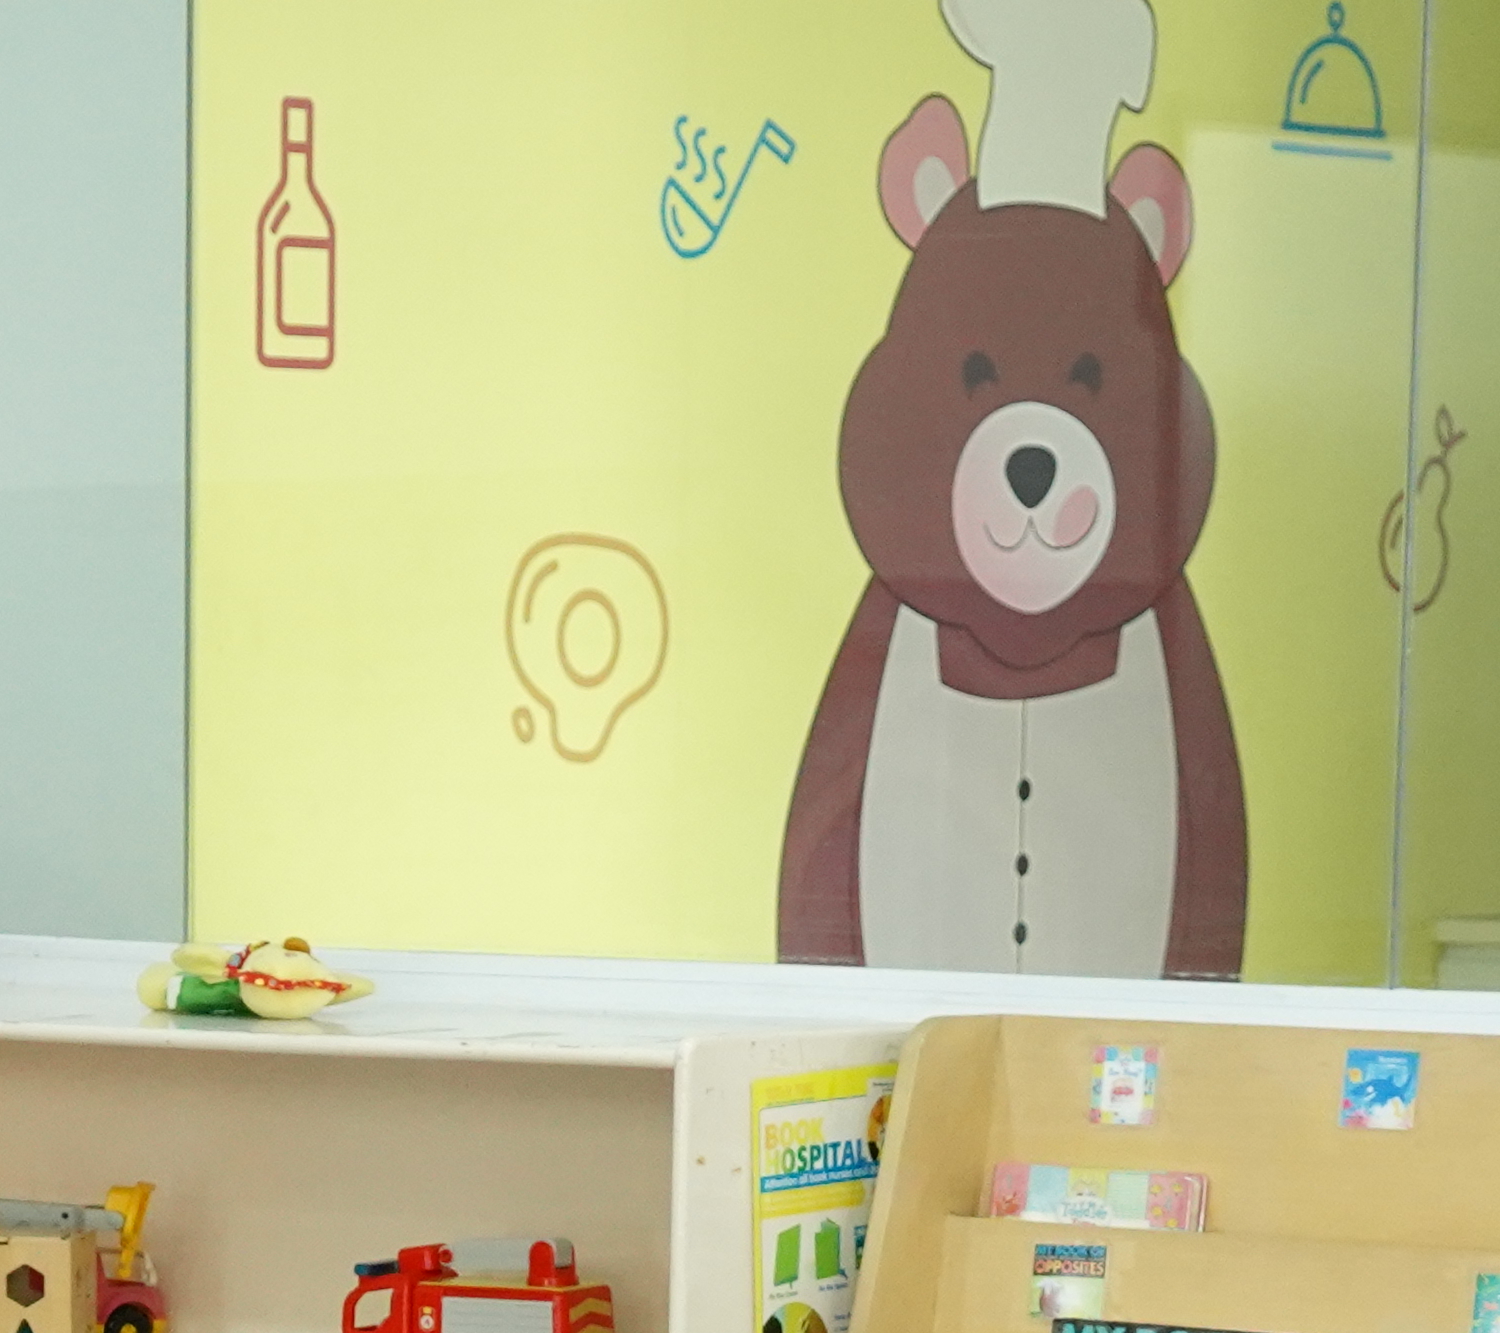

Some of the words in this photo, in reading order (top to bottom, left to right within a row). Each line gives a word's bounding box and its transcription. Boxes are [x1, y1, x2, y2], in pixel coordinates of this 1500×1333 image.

[764, 1117, 825, 1149] BOOK
[764, 1138, 868, 1175] HOSPITAL
[1035, 1258, 1104, 1275] OPPOSITES
